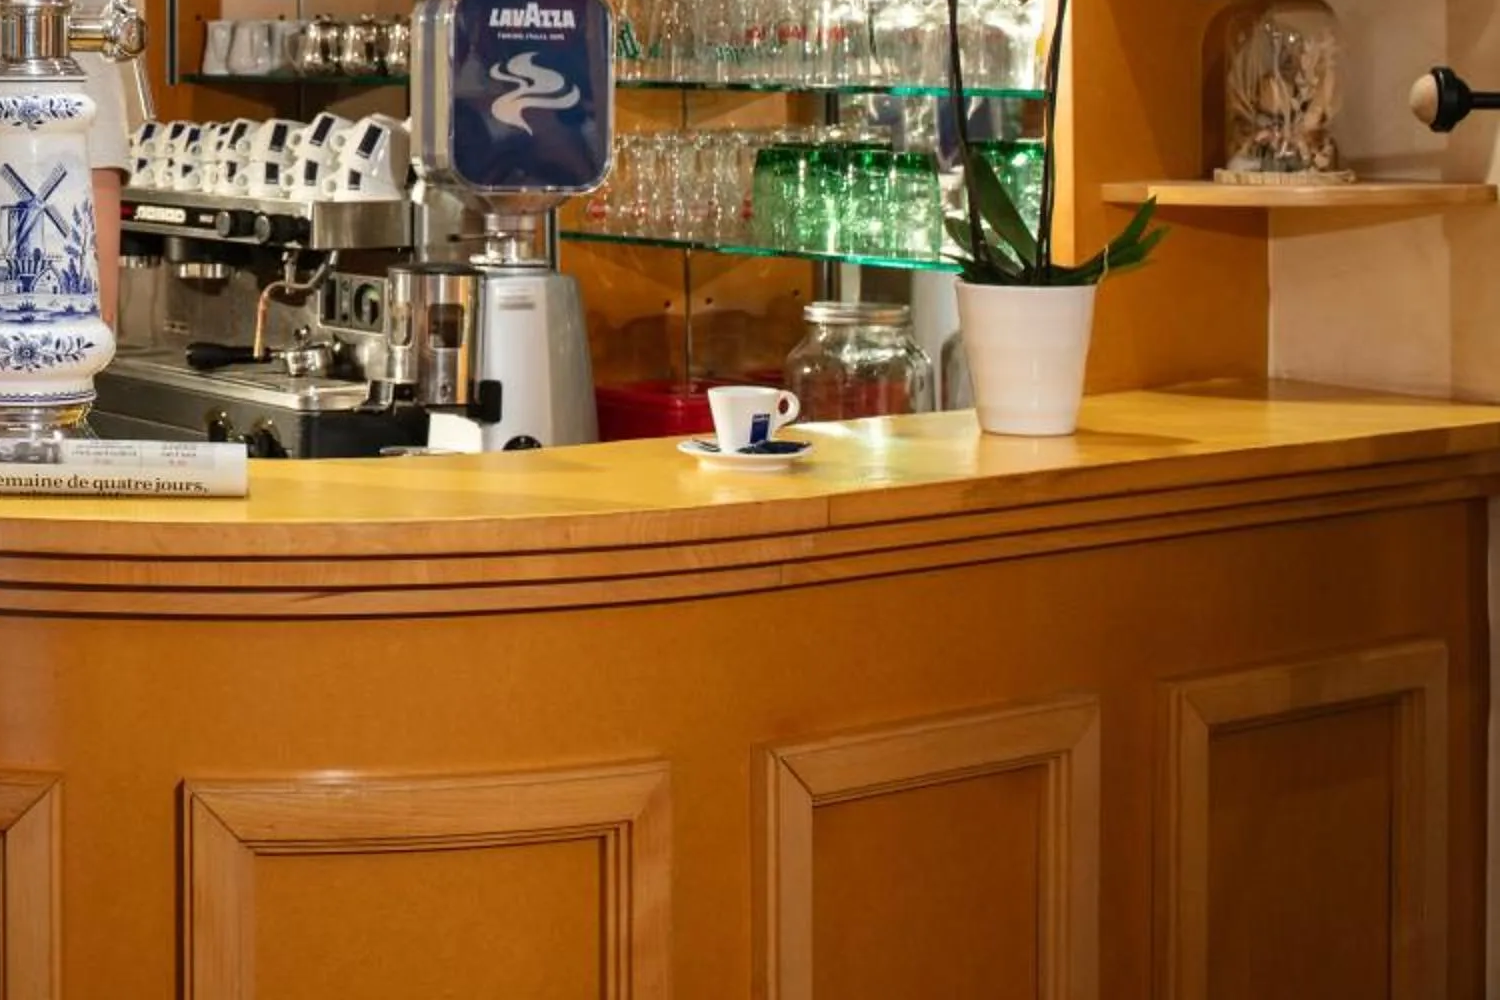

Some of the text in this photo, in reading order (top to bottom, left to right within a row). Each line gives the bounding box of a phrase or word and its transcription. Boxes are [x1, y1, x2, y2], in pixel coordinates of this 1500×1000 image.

[489, 1, 576, 29] LAVAZZA
[67, 474, 89, 489] de
[93, 478, 153, 493] quatre
